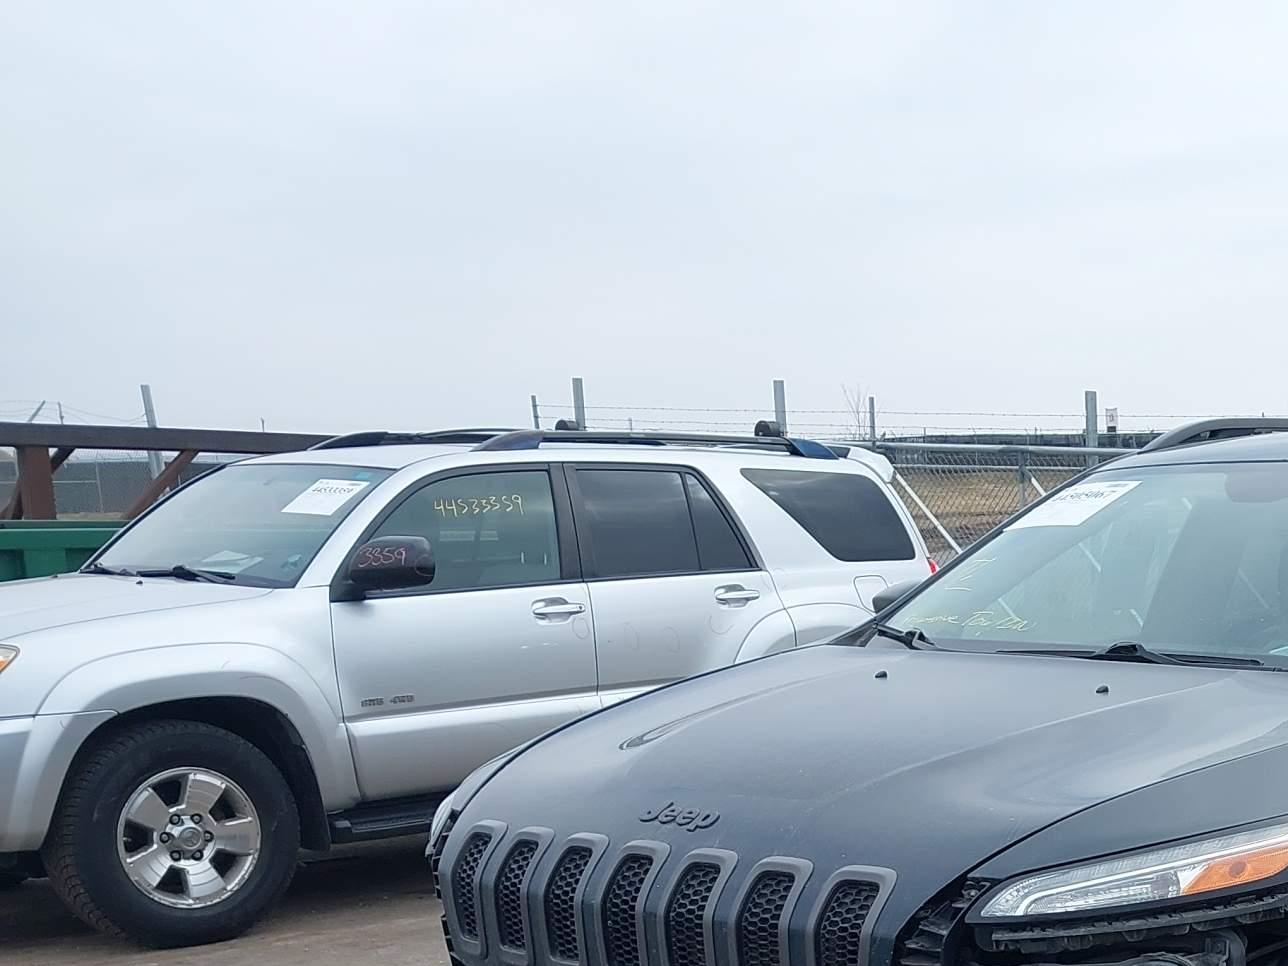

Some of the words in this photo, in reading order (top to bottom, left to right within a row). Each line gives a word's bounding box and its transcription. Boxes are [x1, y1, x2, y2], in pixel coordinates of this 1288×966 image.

[434, 494, 524, 518] 44533359
[358, 546, 406, 568] 3359
[638, 802, 721, 832] Jeep
